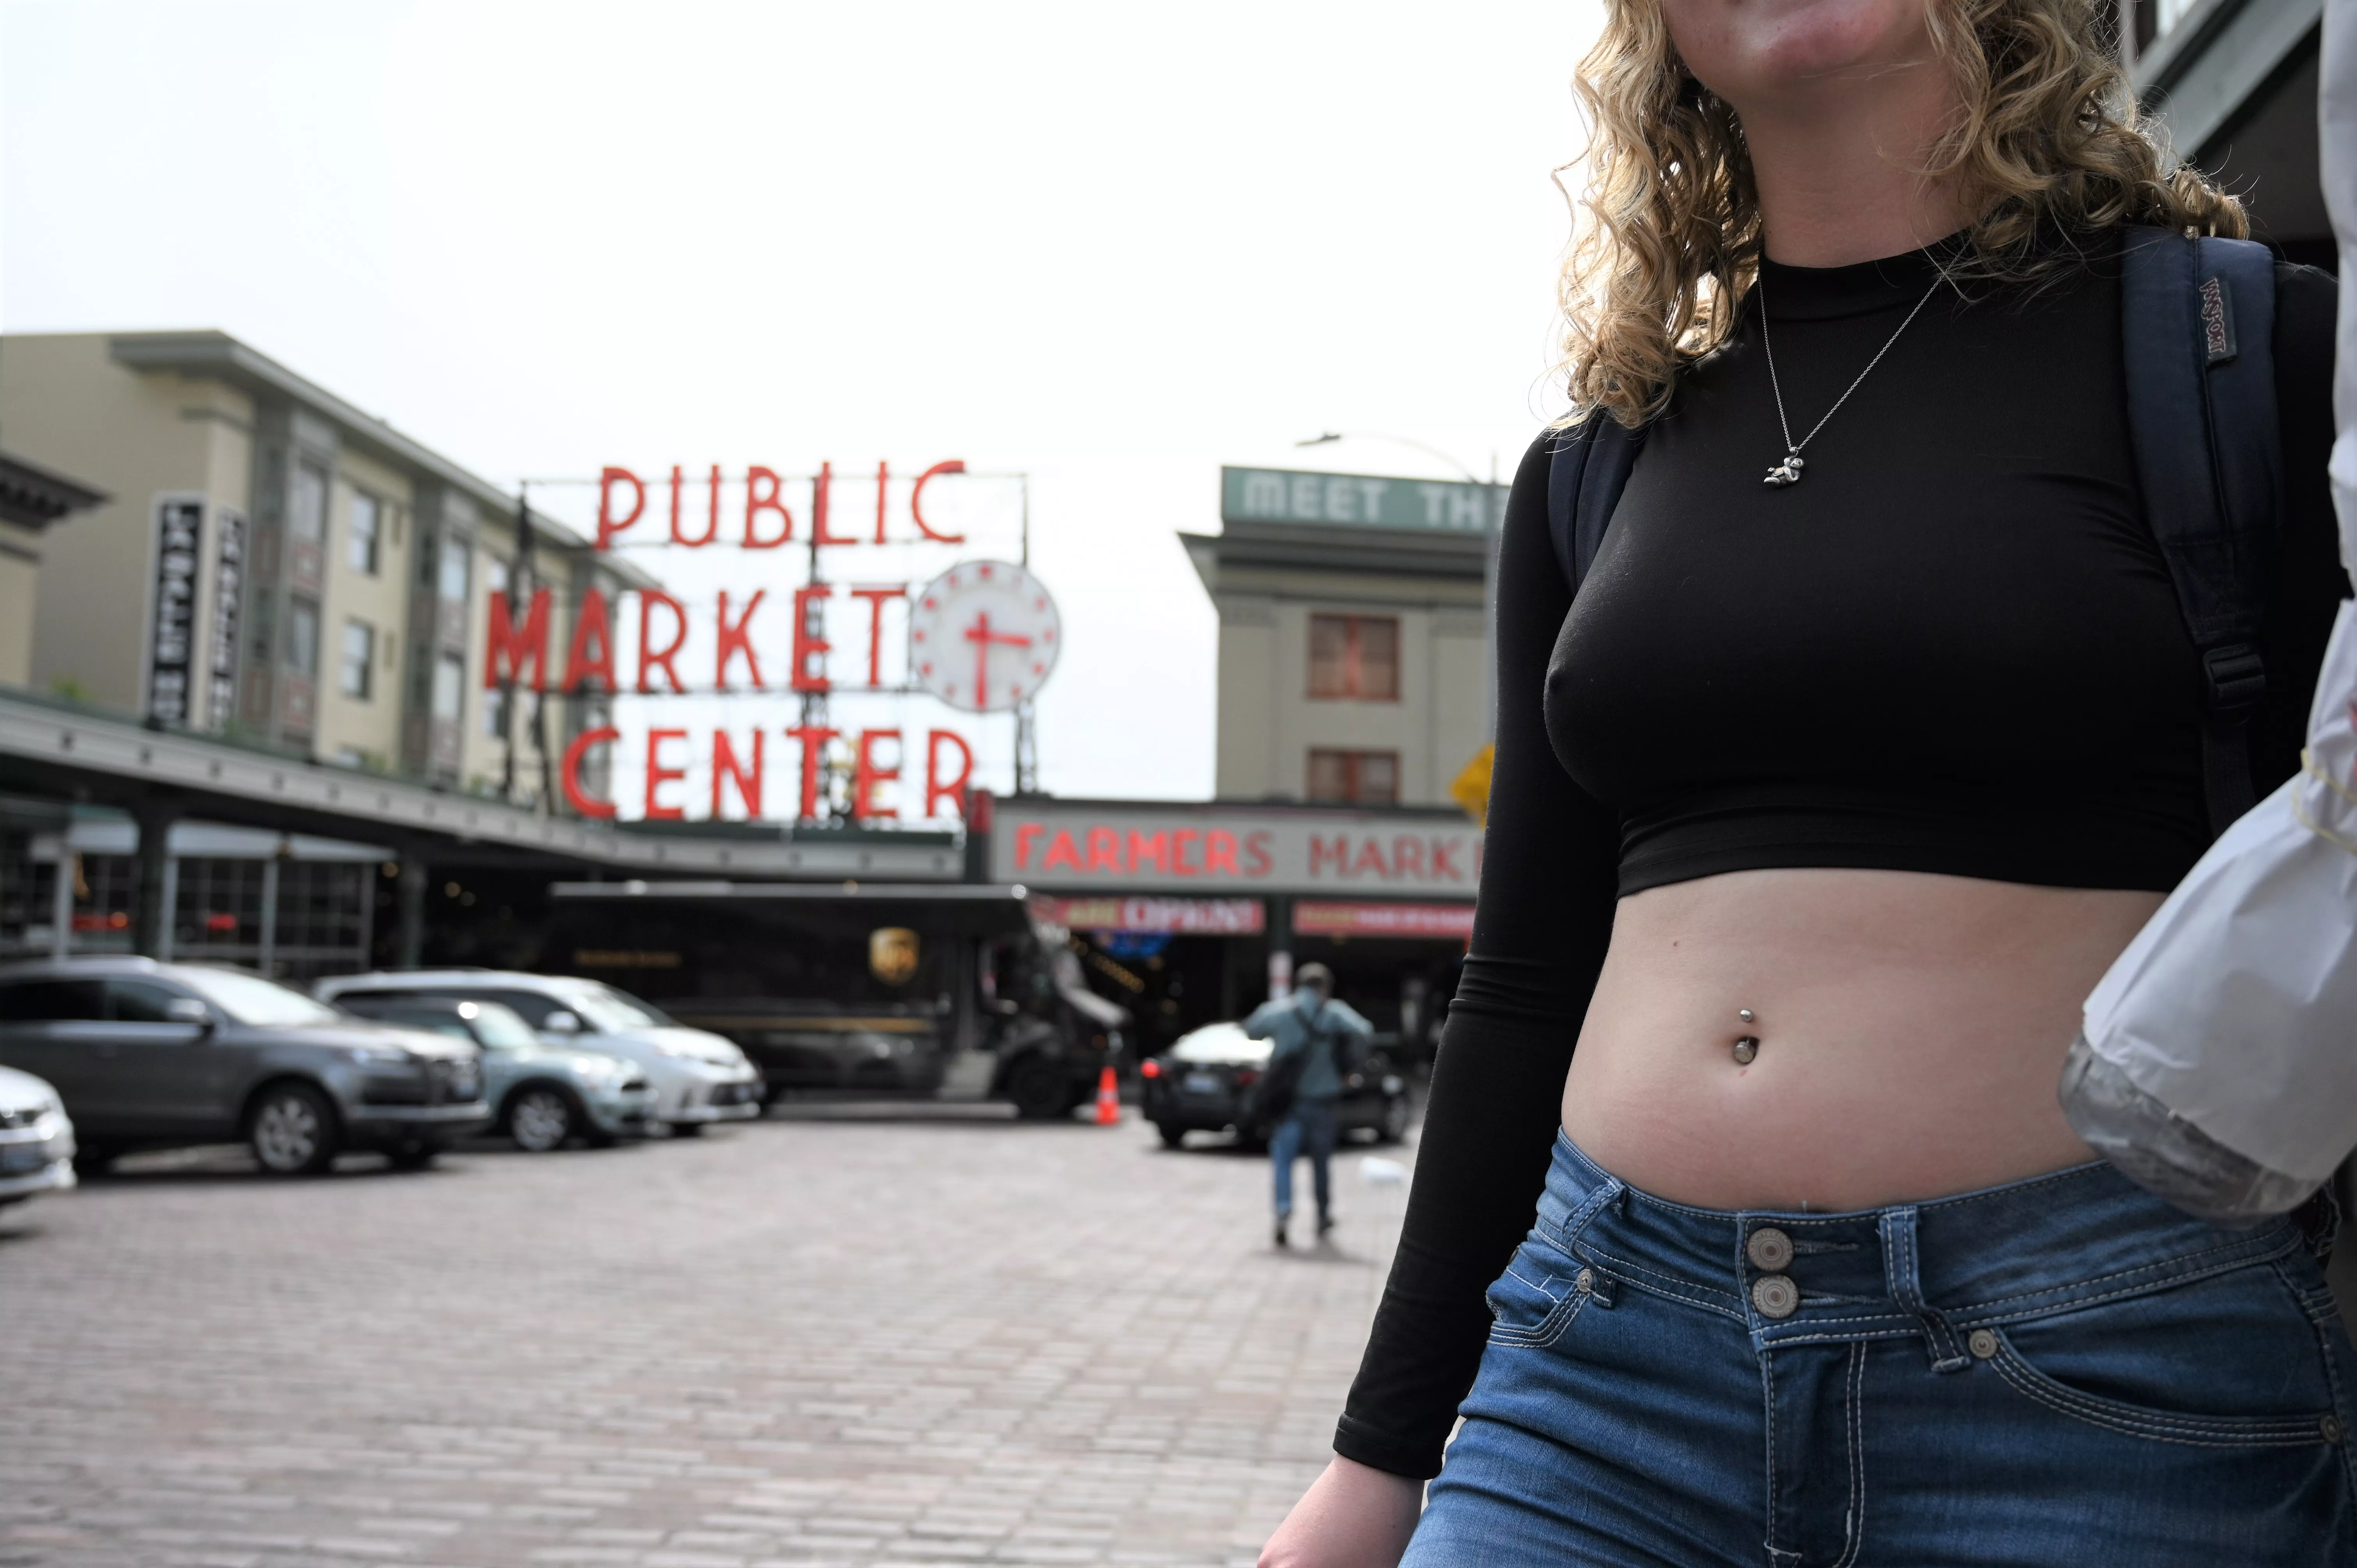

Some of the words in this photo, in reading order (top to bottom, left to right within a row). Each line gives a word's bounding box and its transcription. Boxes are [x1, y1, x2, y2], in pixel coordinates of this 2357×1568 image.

[594, 461, 965, 551] PUBLIC
[1244, 472, 1387, 523] MEET
[483, 583, 909, 694] MARKET
[561, 727, 974, 821] CENTER
[1013, 822, 1275, 878] FARMERS
